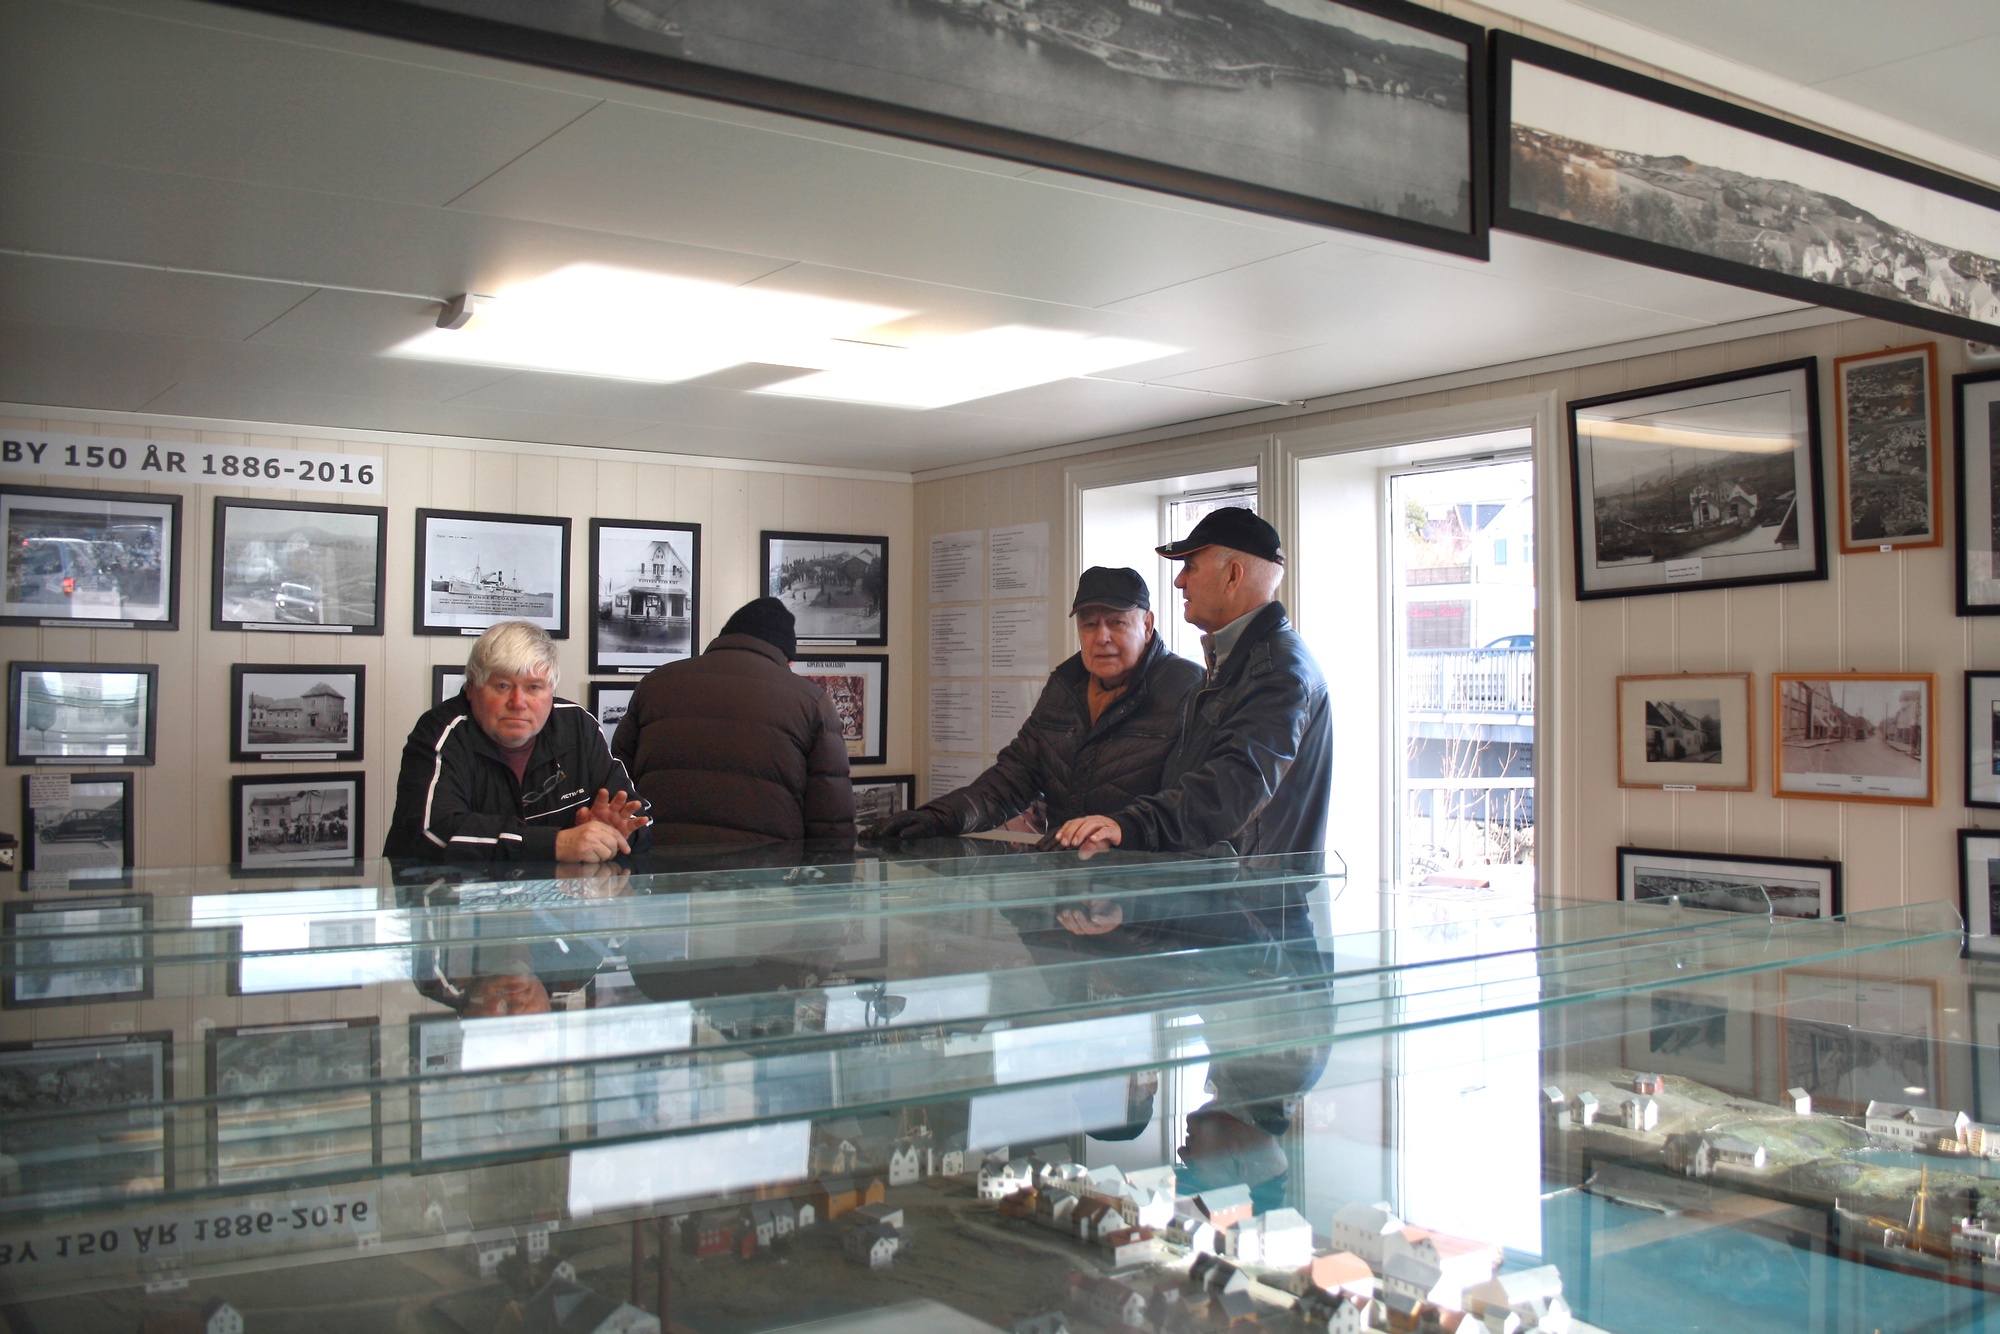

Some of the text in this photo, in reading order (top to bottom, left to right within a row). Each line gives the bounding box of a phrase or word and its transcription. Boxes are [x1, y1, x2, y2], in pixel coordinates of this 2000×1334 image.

[3, 440, 374, 485] BY 150 ÅR 1886-2016
